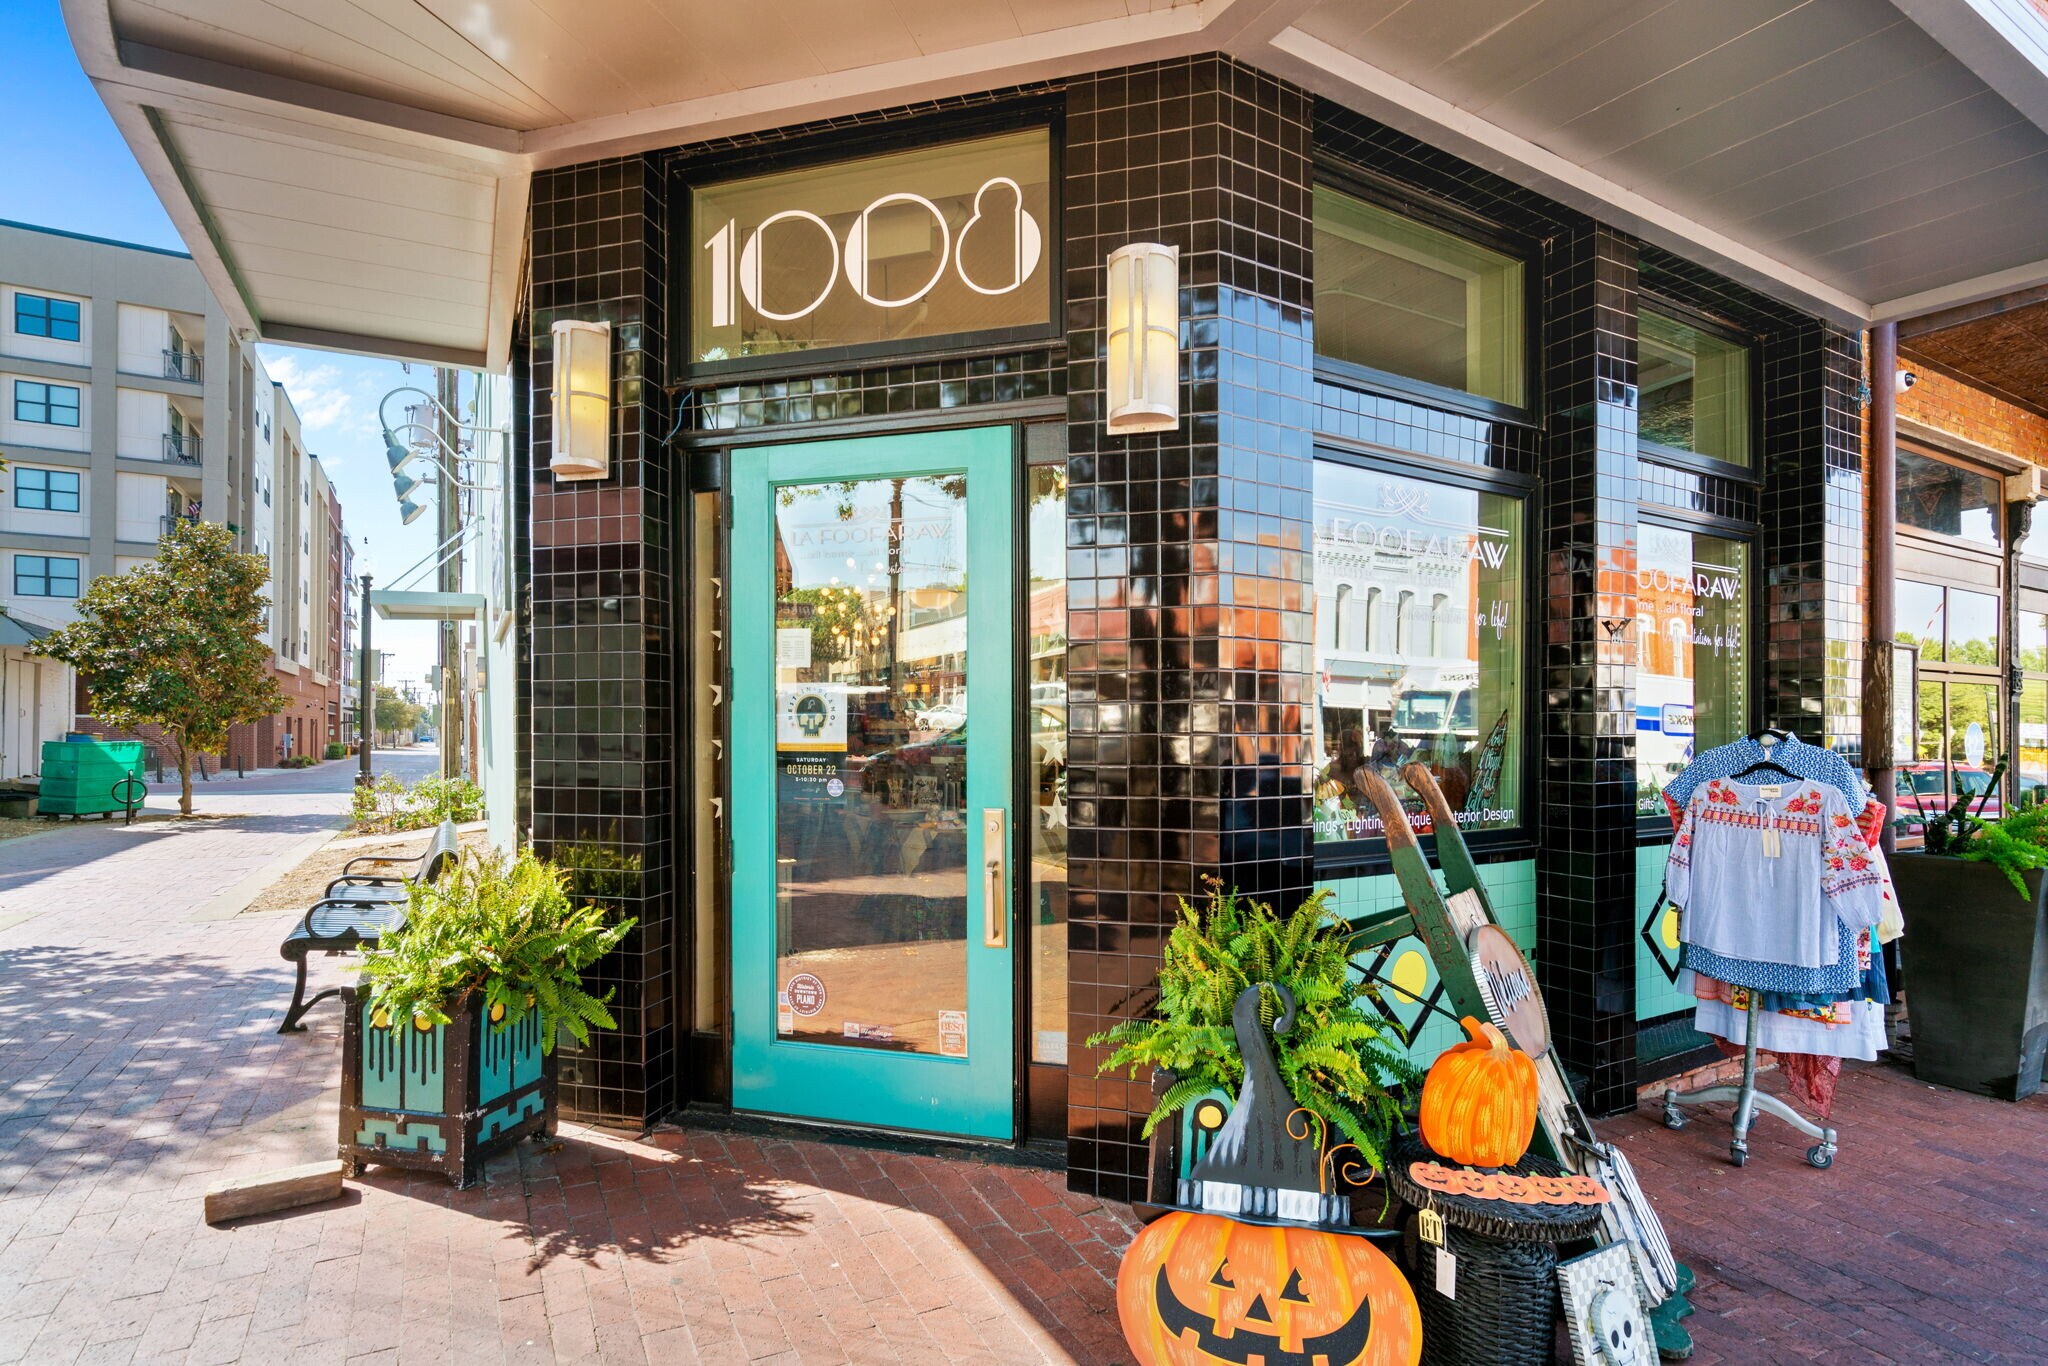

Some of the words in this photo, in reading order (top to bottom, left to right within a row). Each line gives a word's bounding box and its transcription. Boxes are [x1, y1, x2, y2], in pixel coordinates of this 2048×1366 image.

[704, 176, 1042, 327] 1008
[791, 531, 813, 546] LA
[820, 523, 953, 545] FOOFARAW
[1680, 602, 1704, 617] floral
[1475, 598, 1487, 640] for
[1491, 600, 1509, 640] life!
[1714, 623, 1724, 657] for
[1726, 624, 1738, 658] life!
[787, 764, 823, 775] OCTOBER
[826, 765, 837, 775] 22
[1638, 798, 1655, 810] Gifts
[1483, 808, 1514, 823] Design
[796, 994, 815, 1005] PLANO
